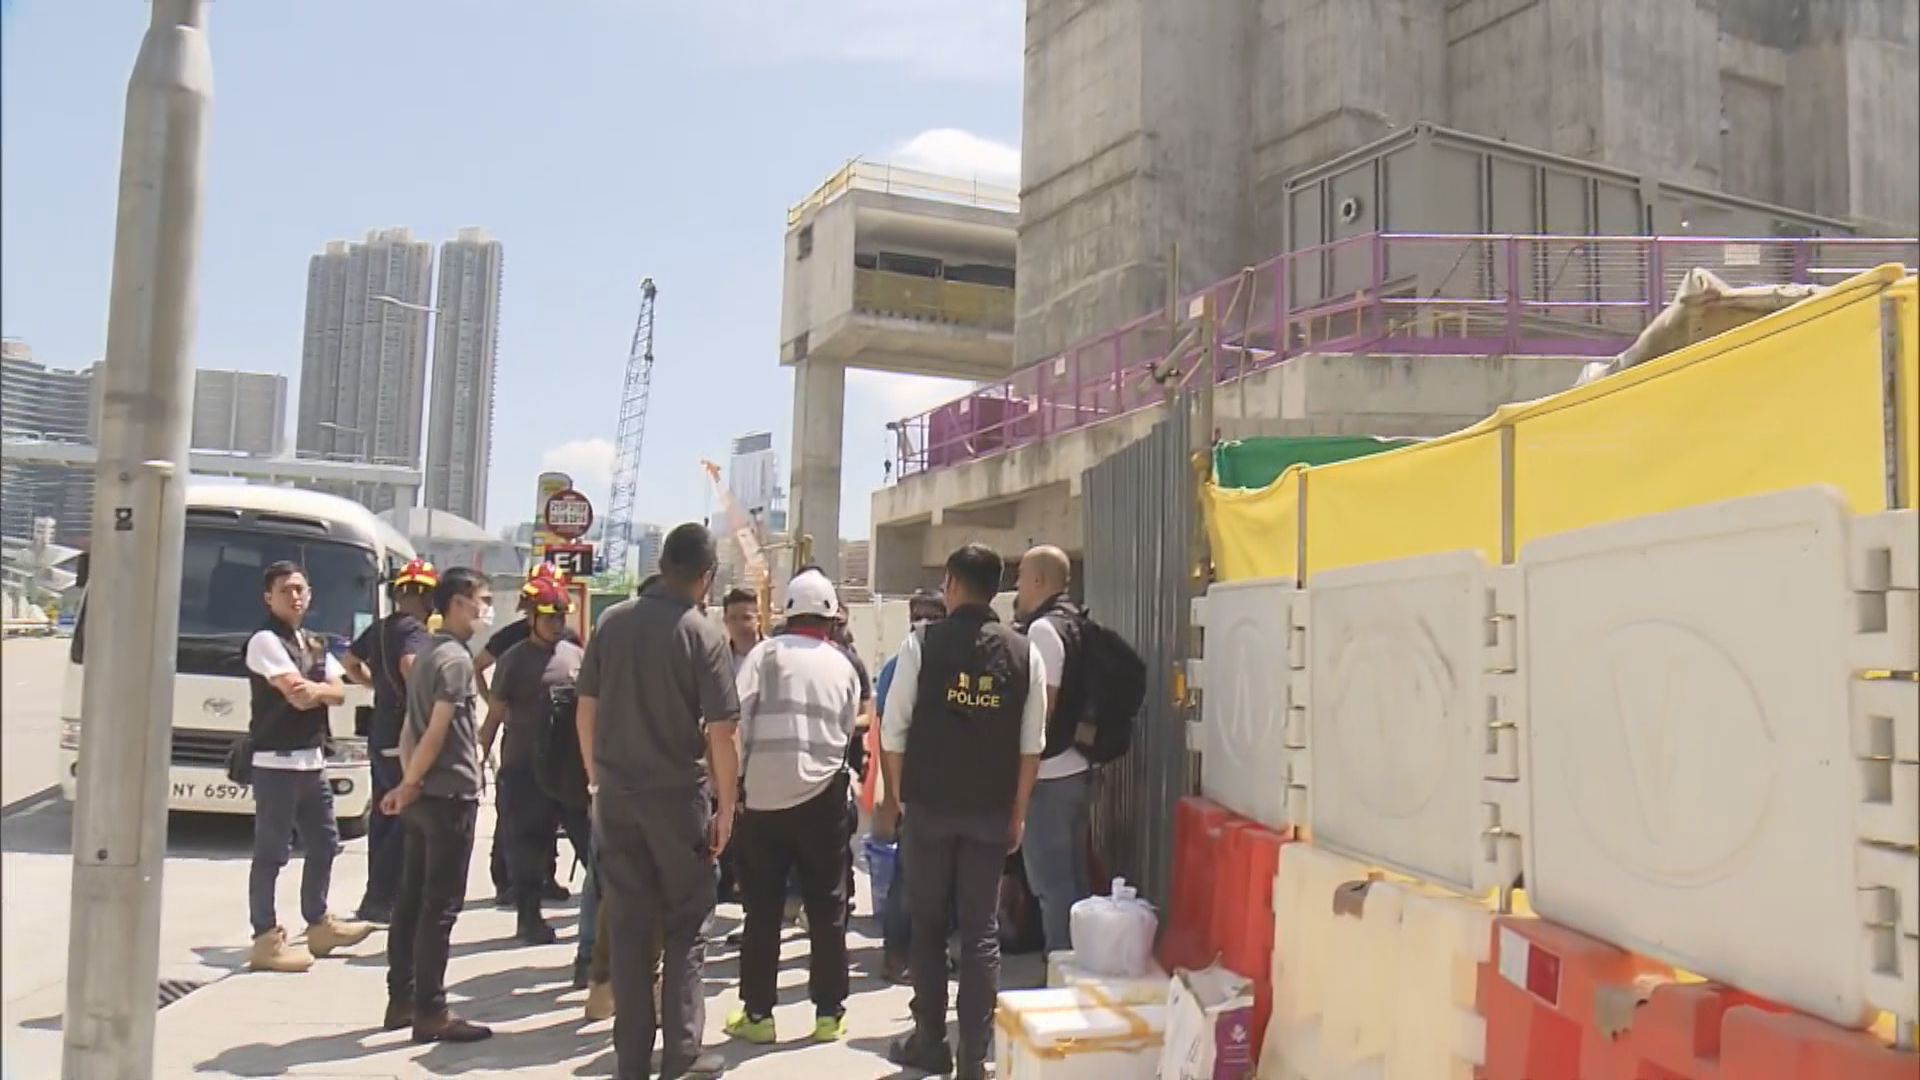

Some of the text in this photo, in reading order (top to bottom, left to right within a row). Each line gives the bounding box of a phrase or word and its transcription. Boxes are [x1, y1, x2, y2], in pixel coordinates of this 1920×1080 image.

[553, 552, 581, 574] E1
[947, 688, 1001, 707] POLICE
[173, 783, 249, 799] NY 6597
